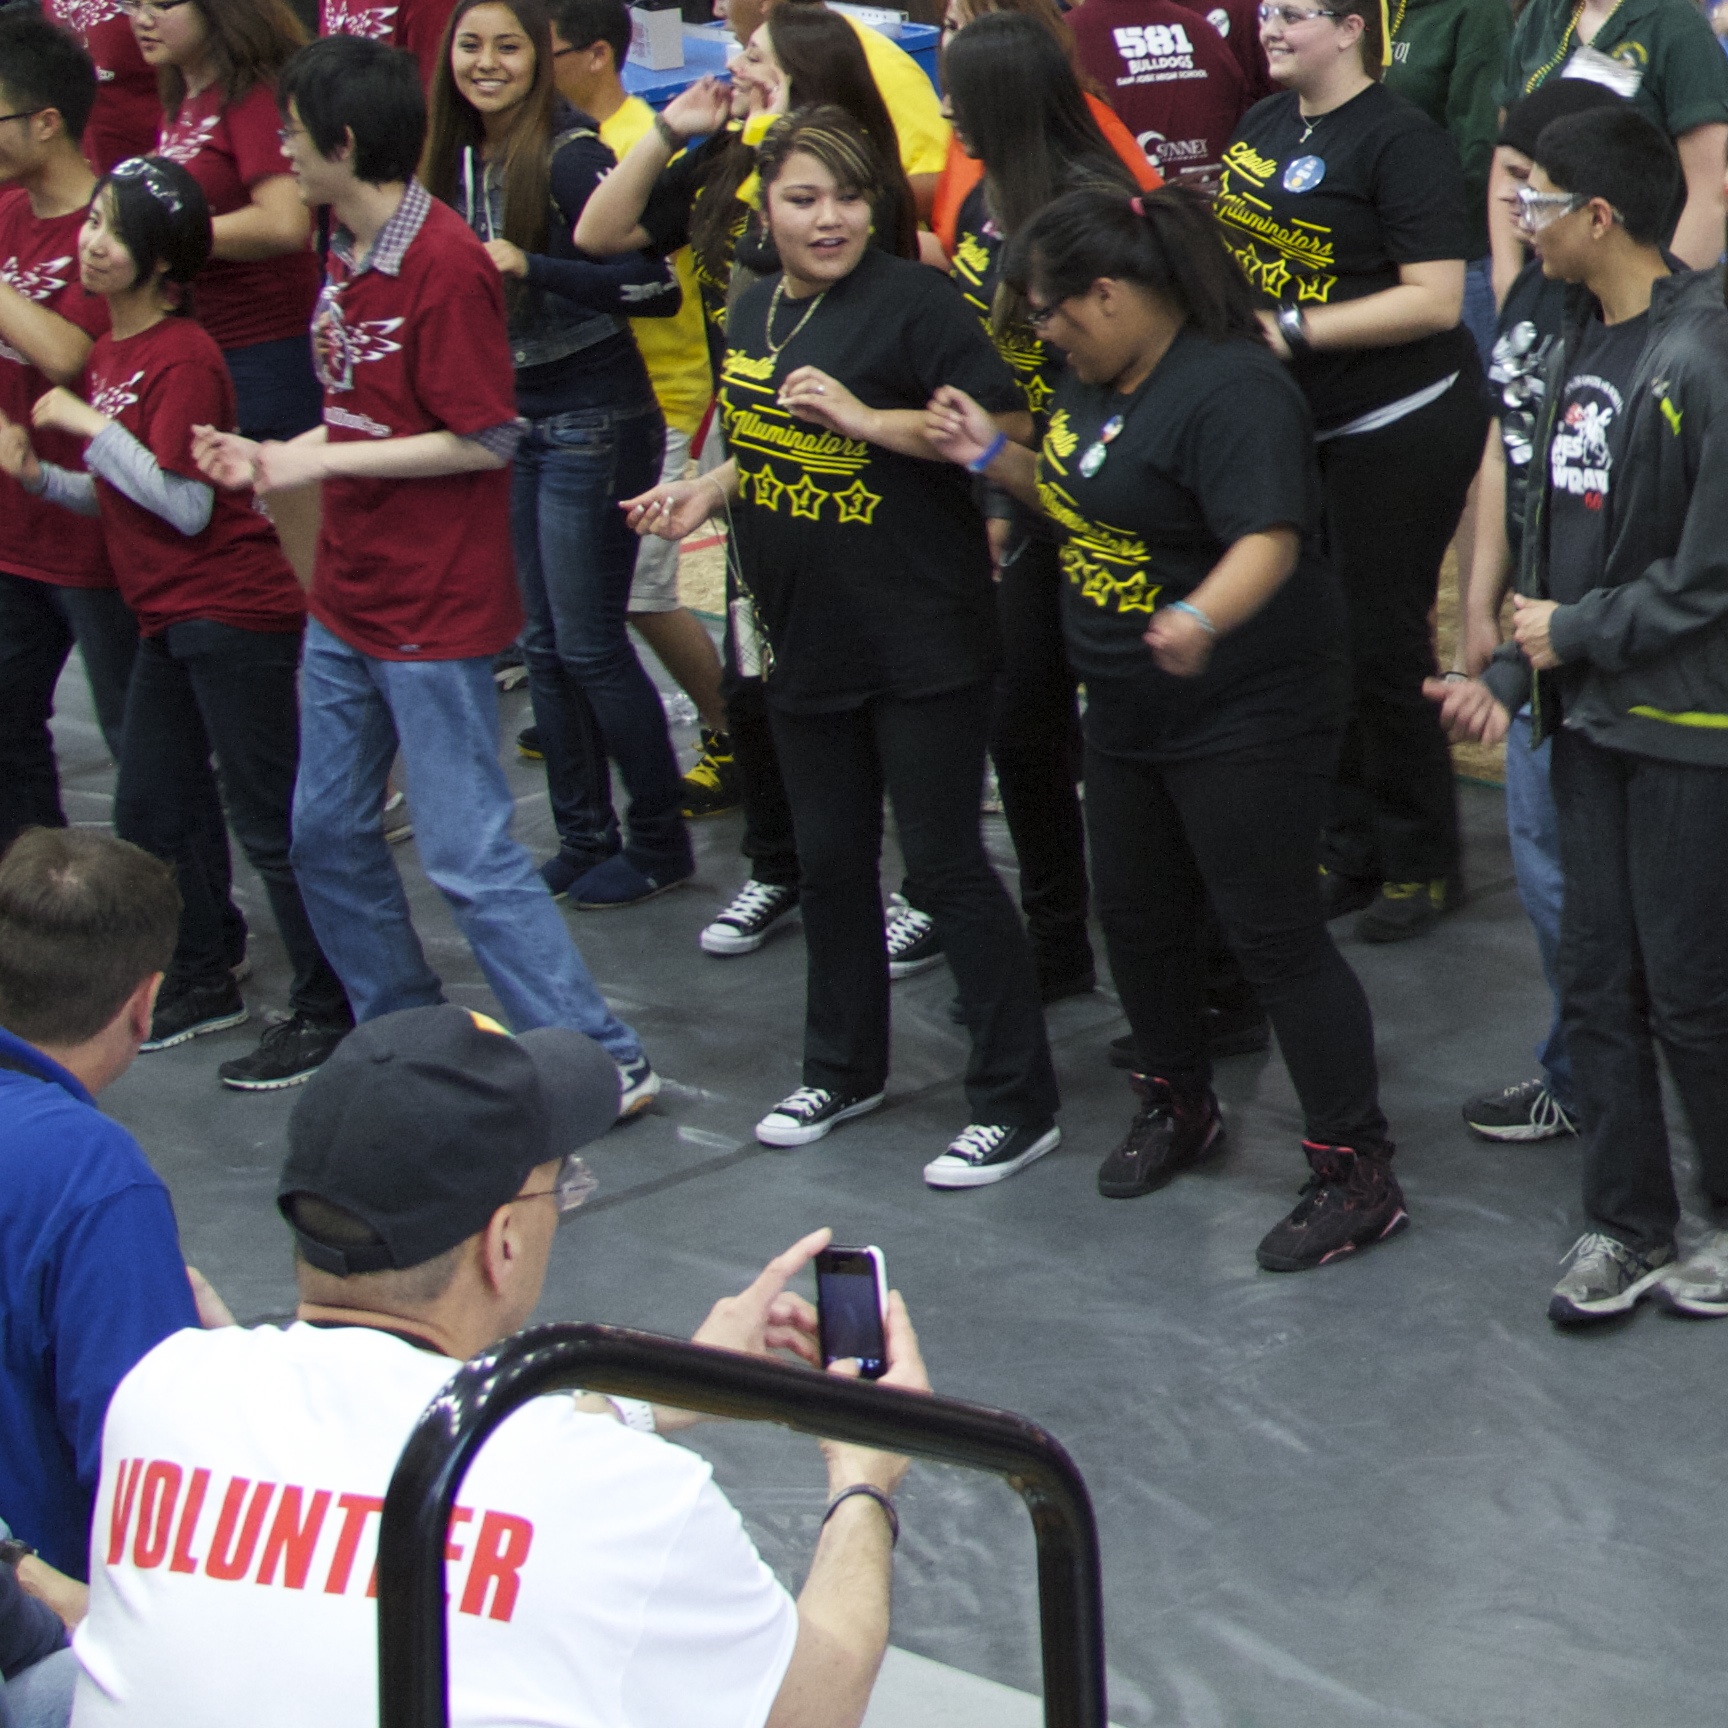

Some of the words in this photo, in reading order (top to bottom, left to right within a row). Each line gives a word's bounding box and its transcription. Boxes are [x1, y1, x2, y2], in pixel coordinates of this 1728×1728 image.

[1112, 22, 1195, 60] 581
[1127, 54, 1195, 75] BULLDOGS
[731, 410, 869, 457] Illuminators
